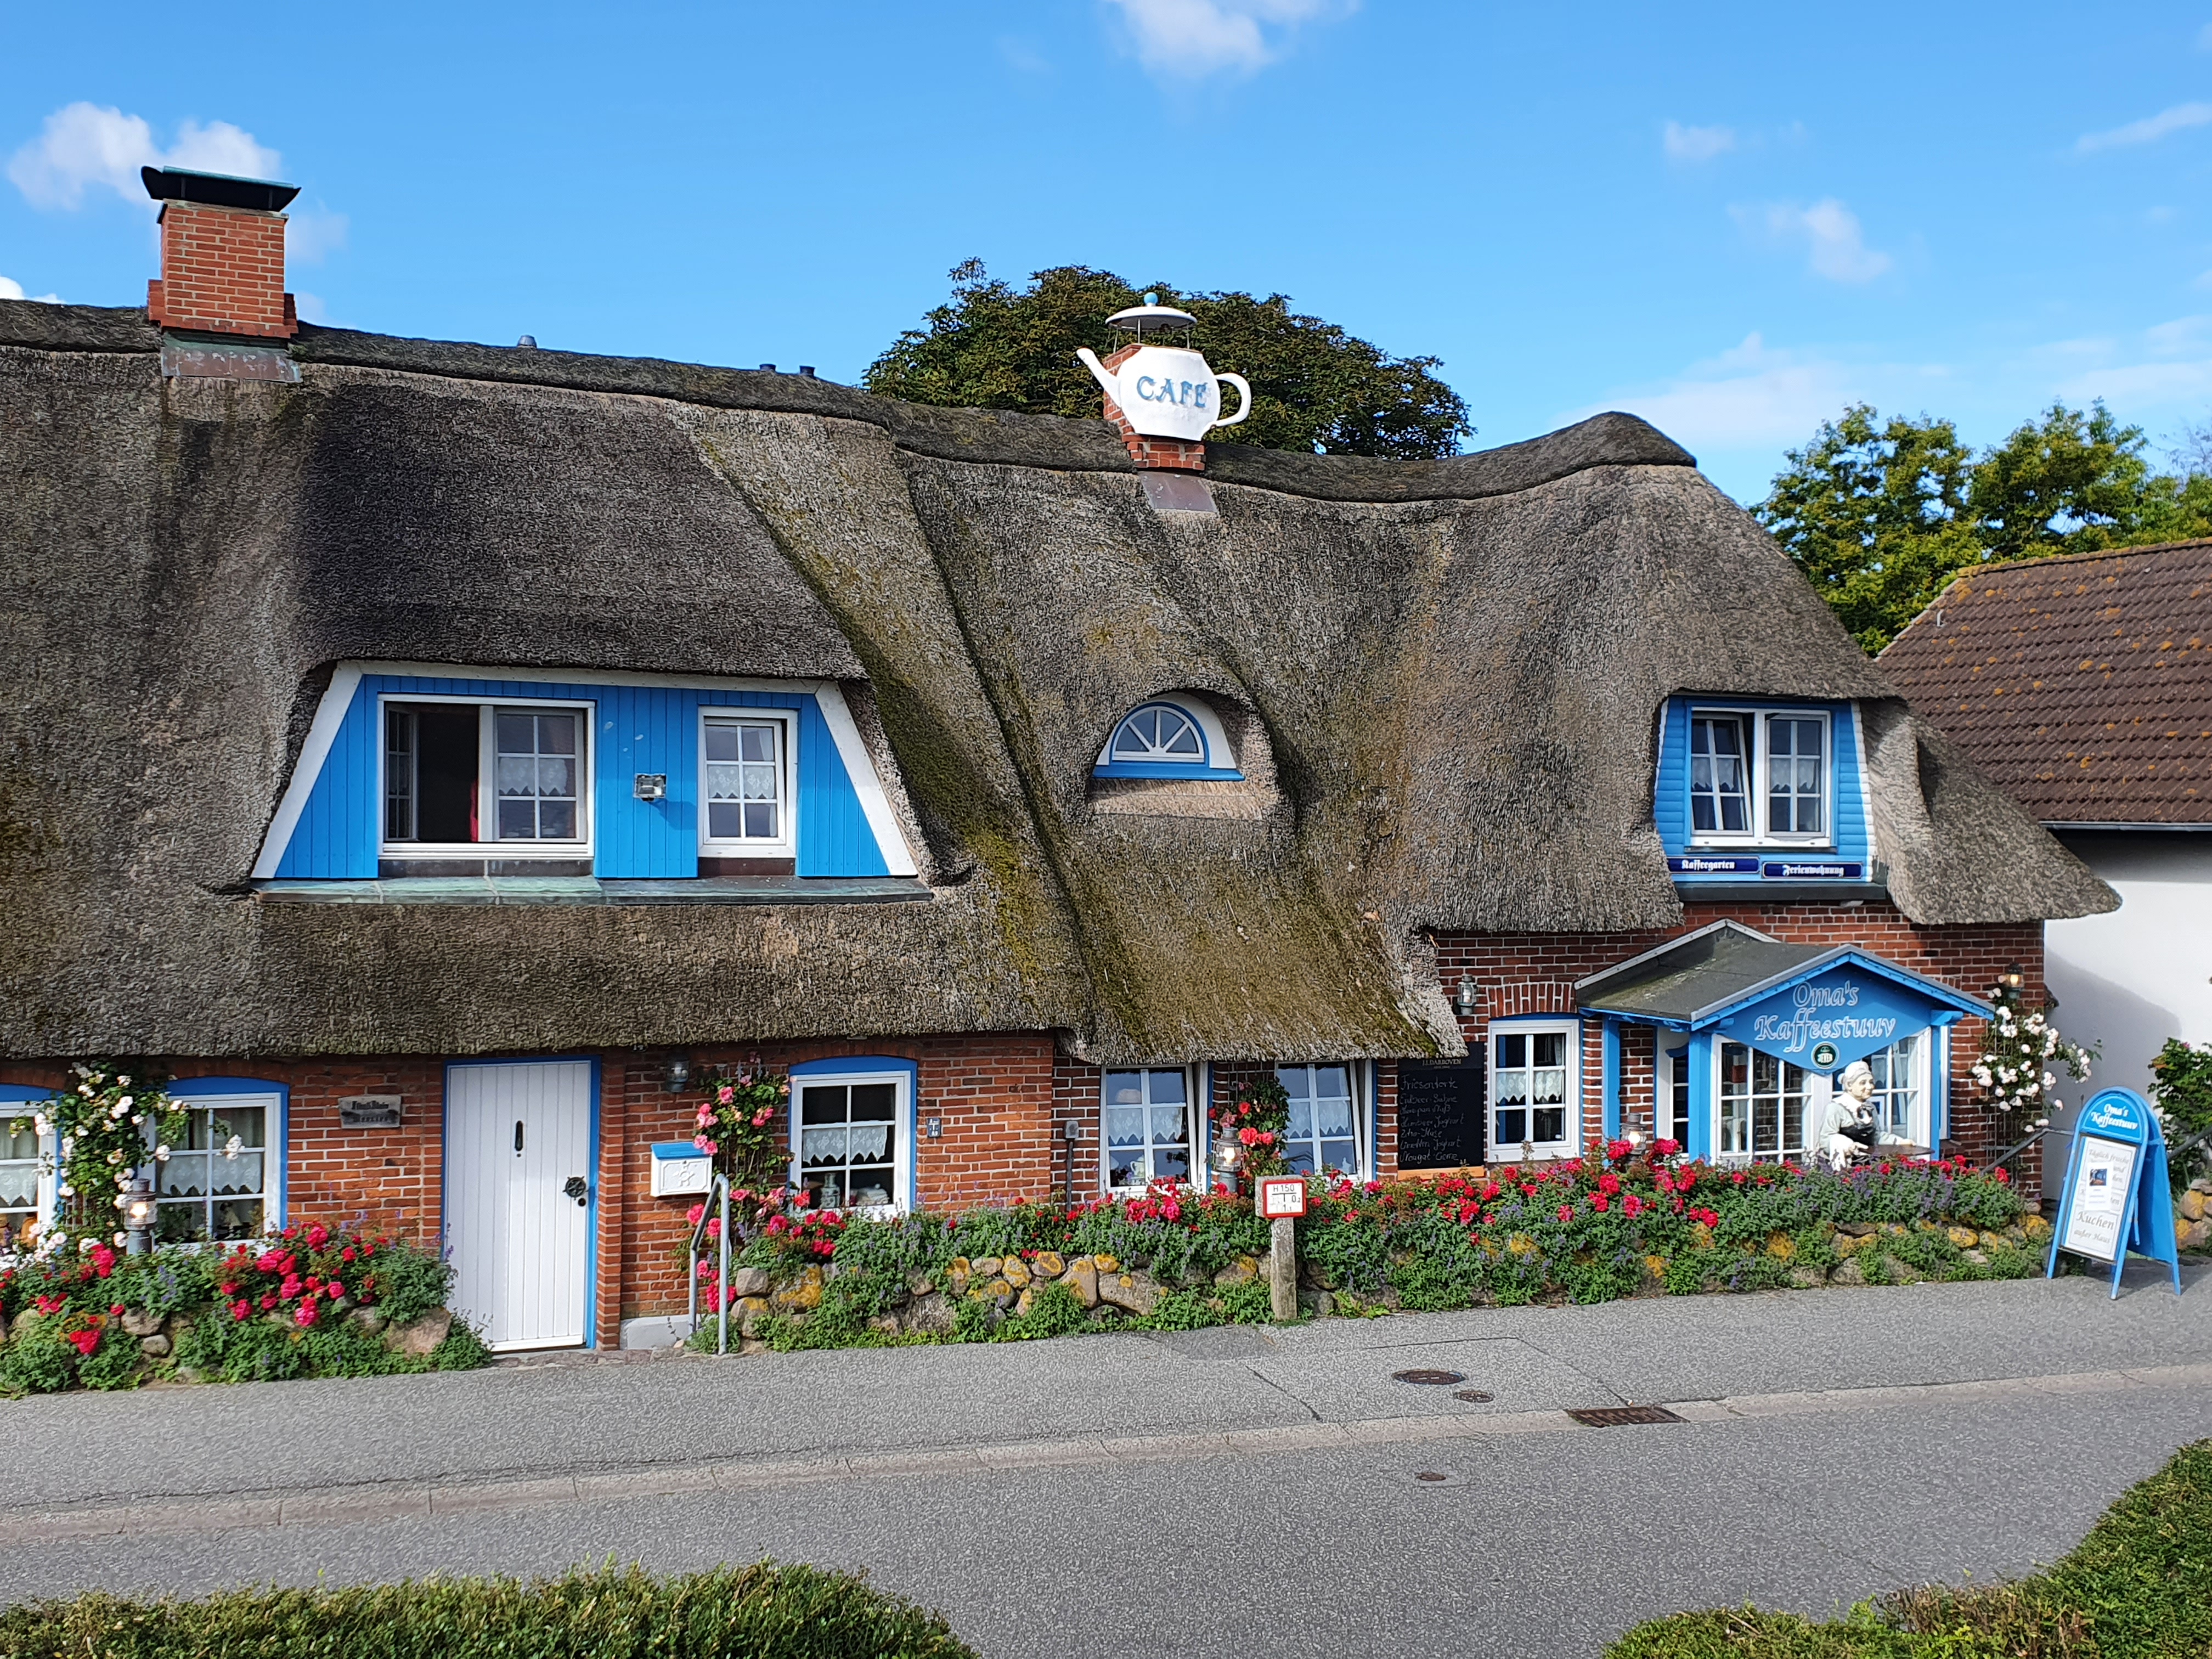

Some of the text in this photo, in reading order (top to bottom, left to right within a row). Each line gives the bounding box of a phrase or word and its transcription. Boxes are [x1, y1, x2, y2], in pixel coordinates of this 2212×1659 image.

[1137, 376, 1208, 408] CAFE
[1681, 859, 1735, 871] Kaffeegarten
[1782, 865, 1844, 877] Ferienwohnung
[1793, 980, 1859, 1007] Oma's
[1754, 1007, 1896, 1053] Kaffeestuuv
[2091, 1111, 2138, 1130] Kaffeestuuv
[2076, 1211, 2114, 1230] Kuchen
